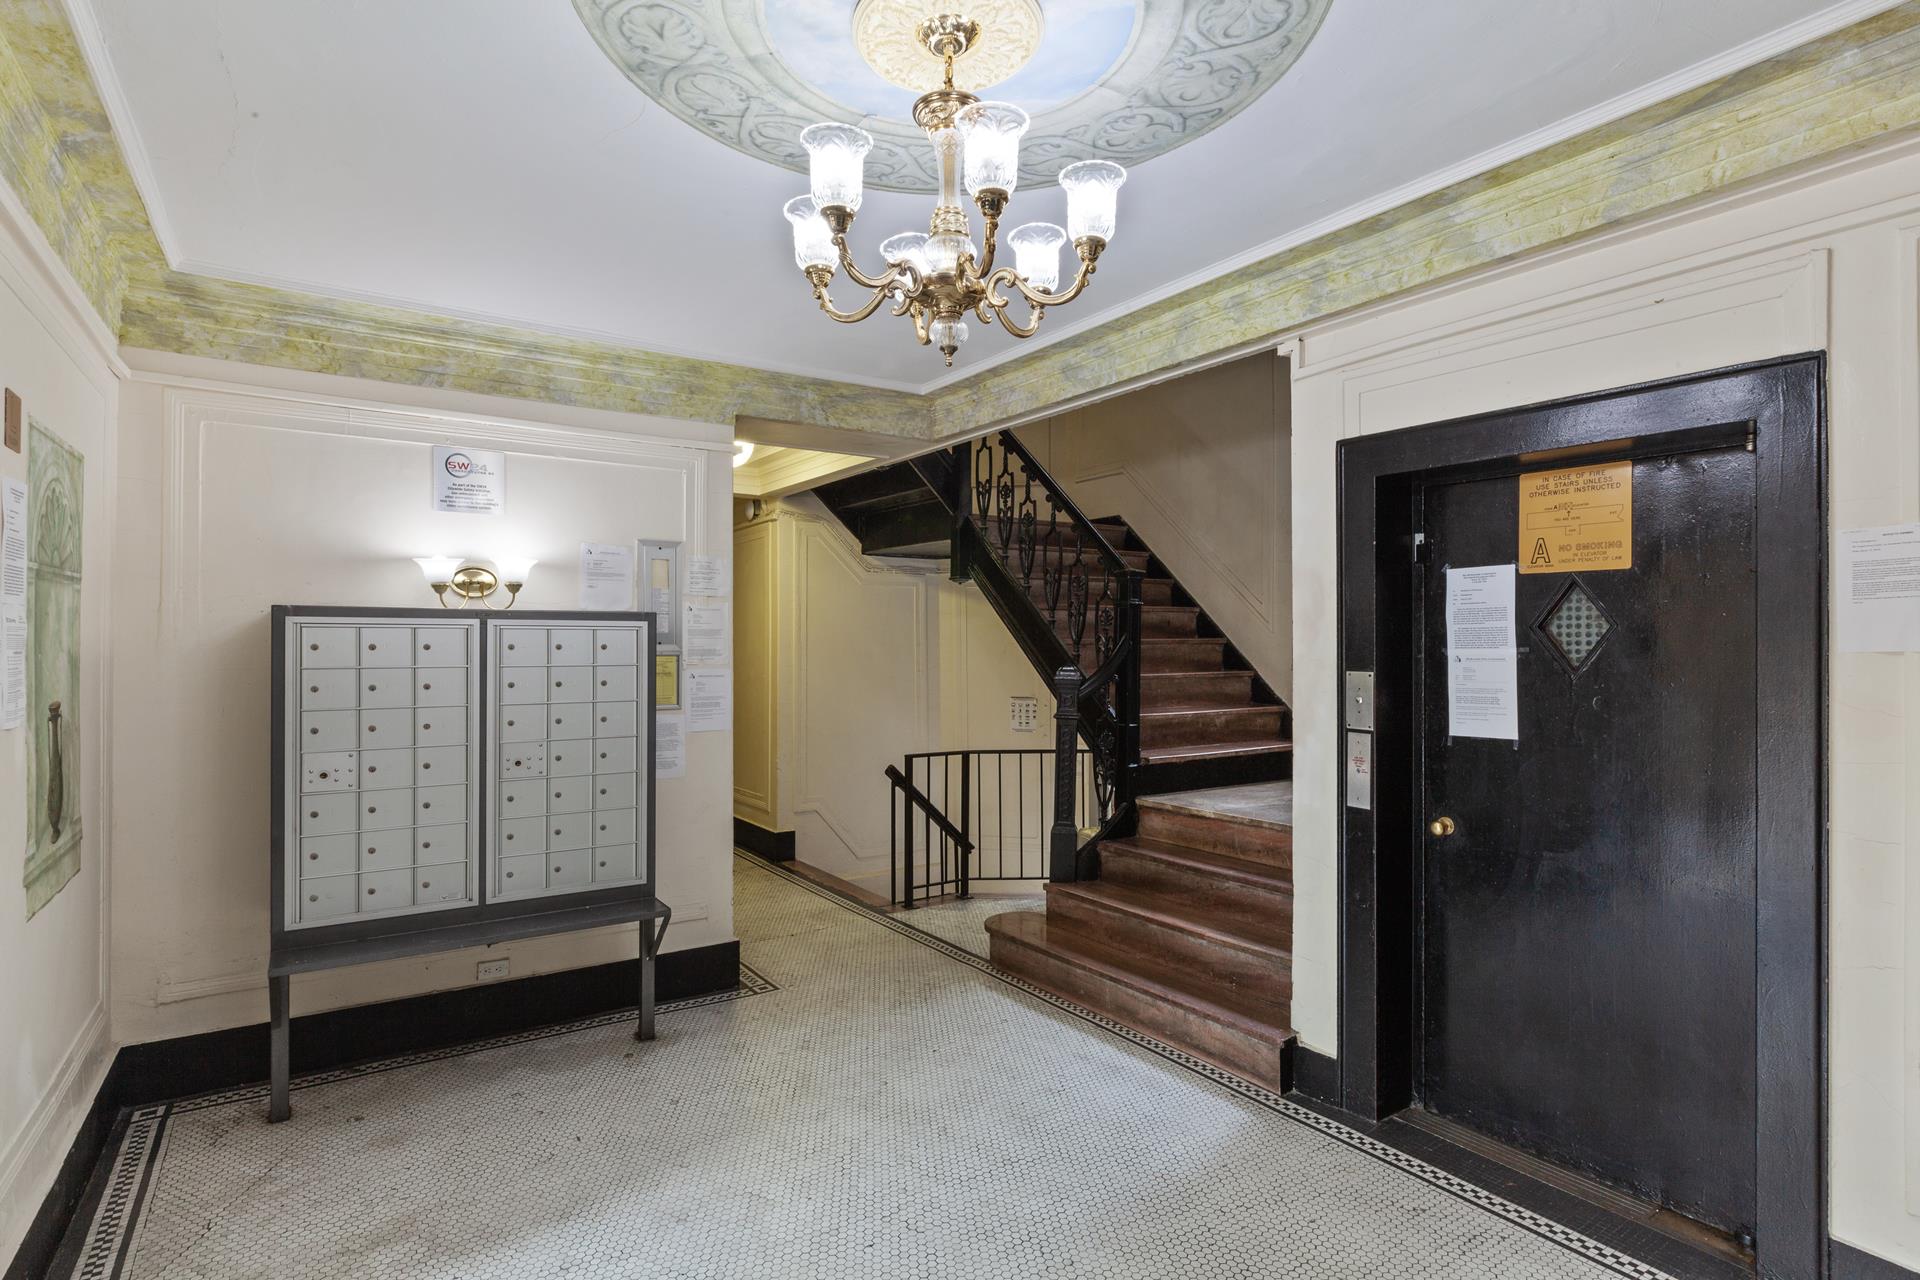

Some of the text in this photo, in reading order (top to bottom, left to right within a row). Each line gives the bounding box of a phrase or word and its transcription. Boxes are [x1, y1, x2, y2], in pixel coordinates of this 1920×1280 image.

[1553, 474, 1571, 482] CASE
[1575, 471, 1586, 479] OF
[1589, 469, 1607, 477] FIRE
[1554, 480, 1580, 488] STAIRS
[1583, 476, 1613, 485] UNLESS
[1528, 482, 1621, 498] OTHERWISE INSTRUCTED
[1530, 537, 1551, 565] A
[1558, 540, 1623, 552] NO SMOKING
